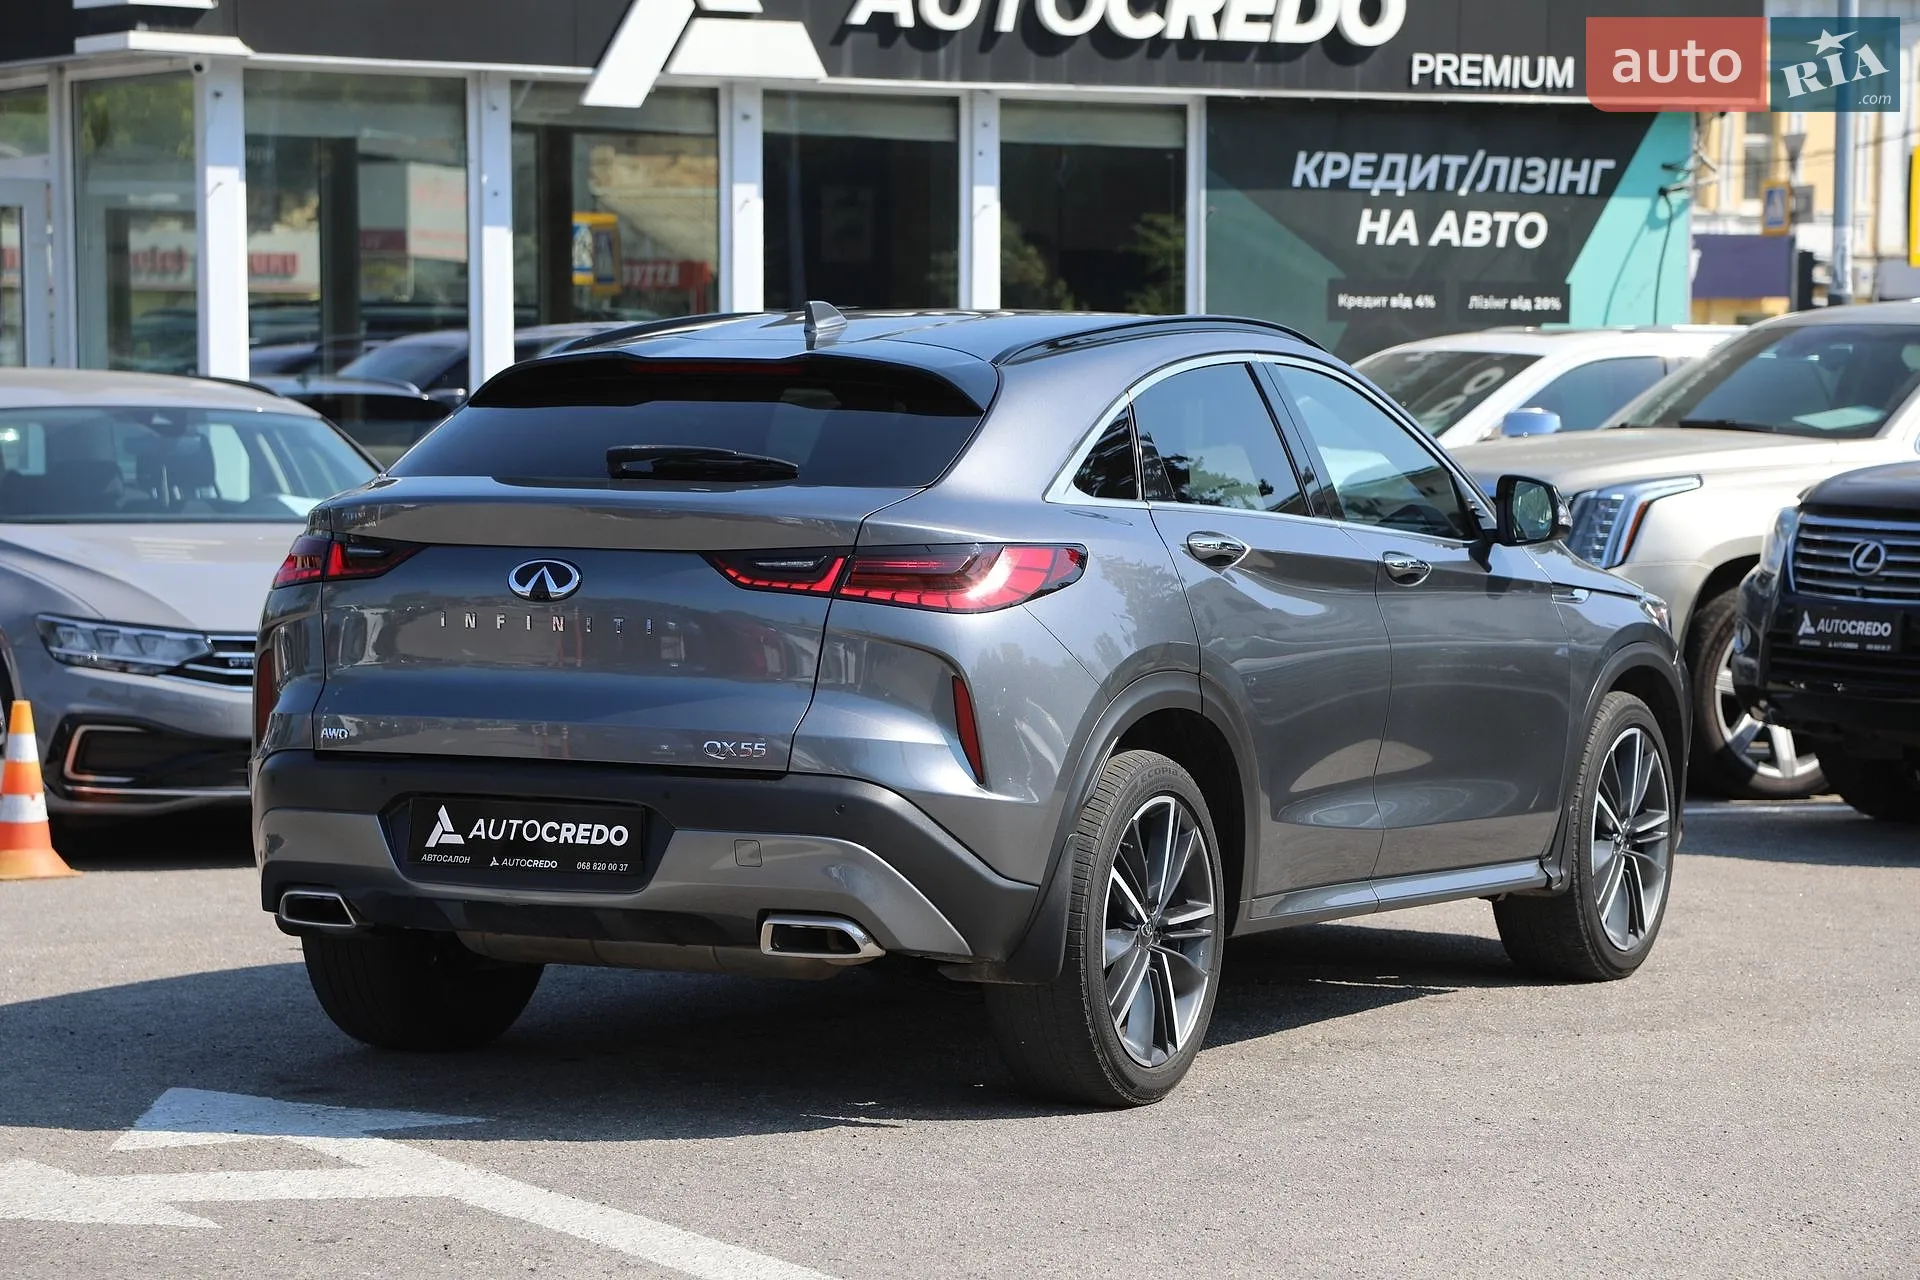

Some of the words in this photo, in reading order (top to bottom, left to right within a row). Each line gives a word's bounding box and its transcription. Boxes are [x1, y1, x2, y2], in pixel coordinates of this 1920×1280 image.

[1411, 52, 1575, 90] PREMIUM
[1291, 149, 1616, 197] КРЕДИТ/ЛІЗІНГ
[1356, 208, 1419, 246] НА
[1428, 209, 1548, 249] АВТО
[1337, 293, 1389, 310] Кредит
[440, 610, 653, 635] INFINITI
[1816, 618, 1892, 637] AUTOCREDO
[321, 727, 349, 740] AWD
[468, 818, 629, 847] AUTOCREDO
[421, 853, 471, 864] АВТОСАЛОН
[501, 857, 558, 869] AUTOCREDO
[576, 861, 591, 870] 068
[592, 862, 607, 871] 820
[607, 862, 618, 871] 00
[619, 863, 629, 871] 37
